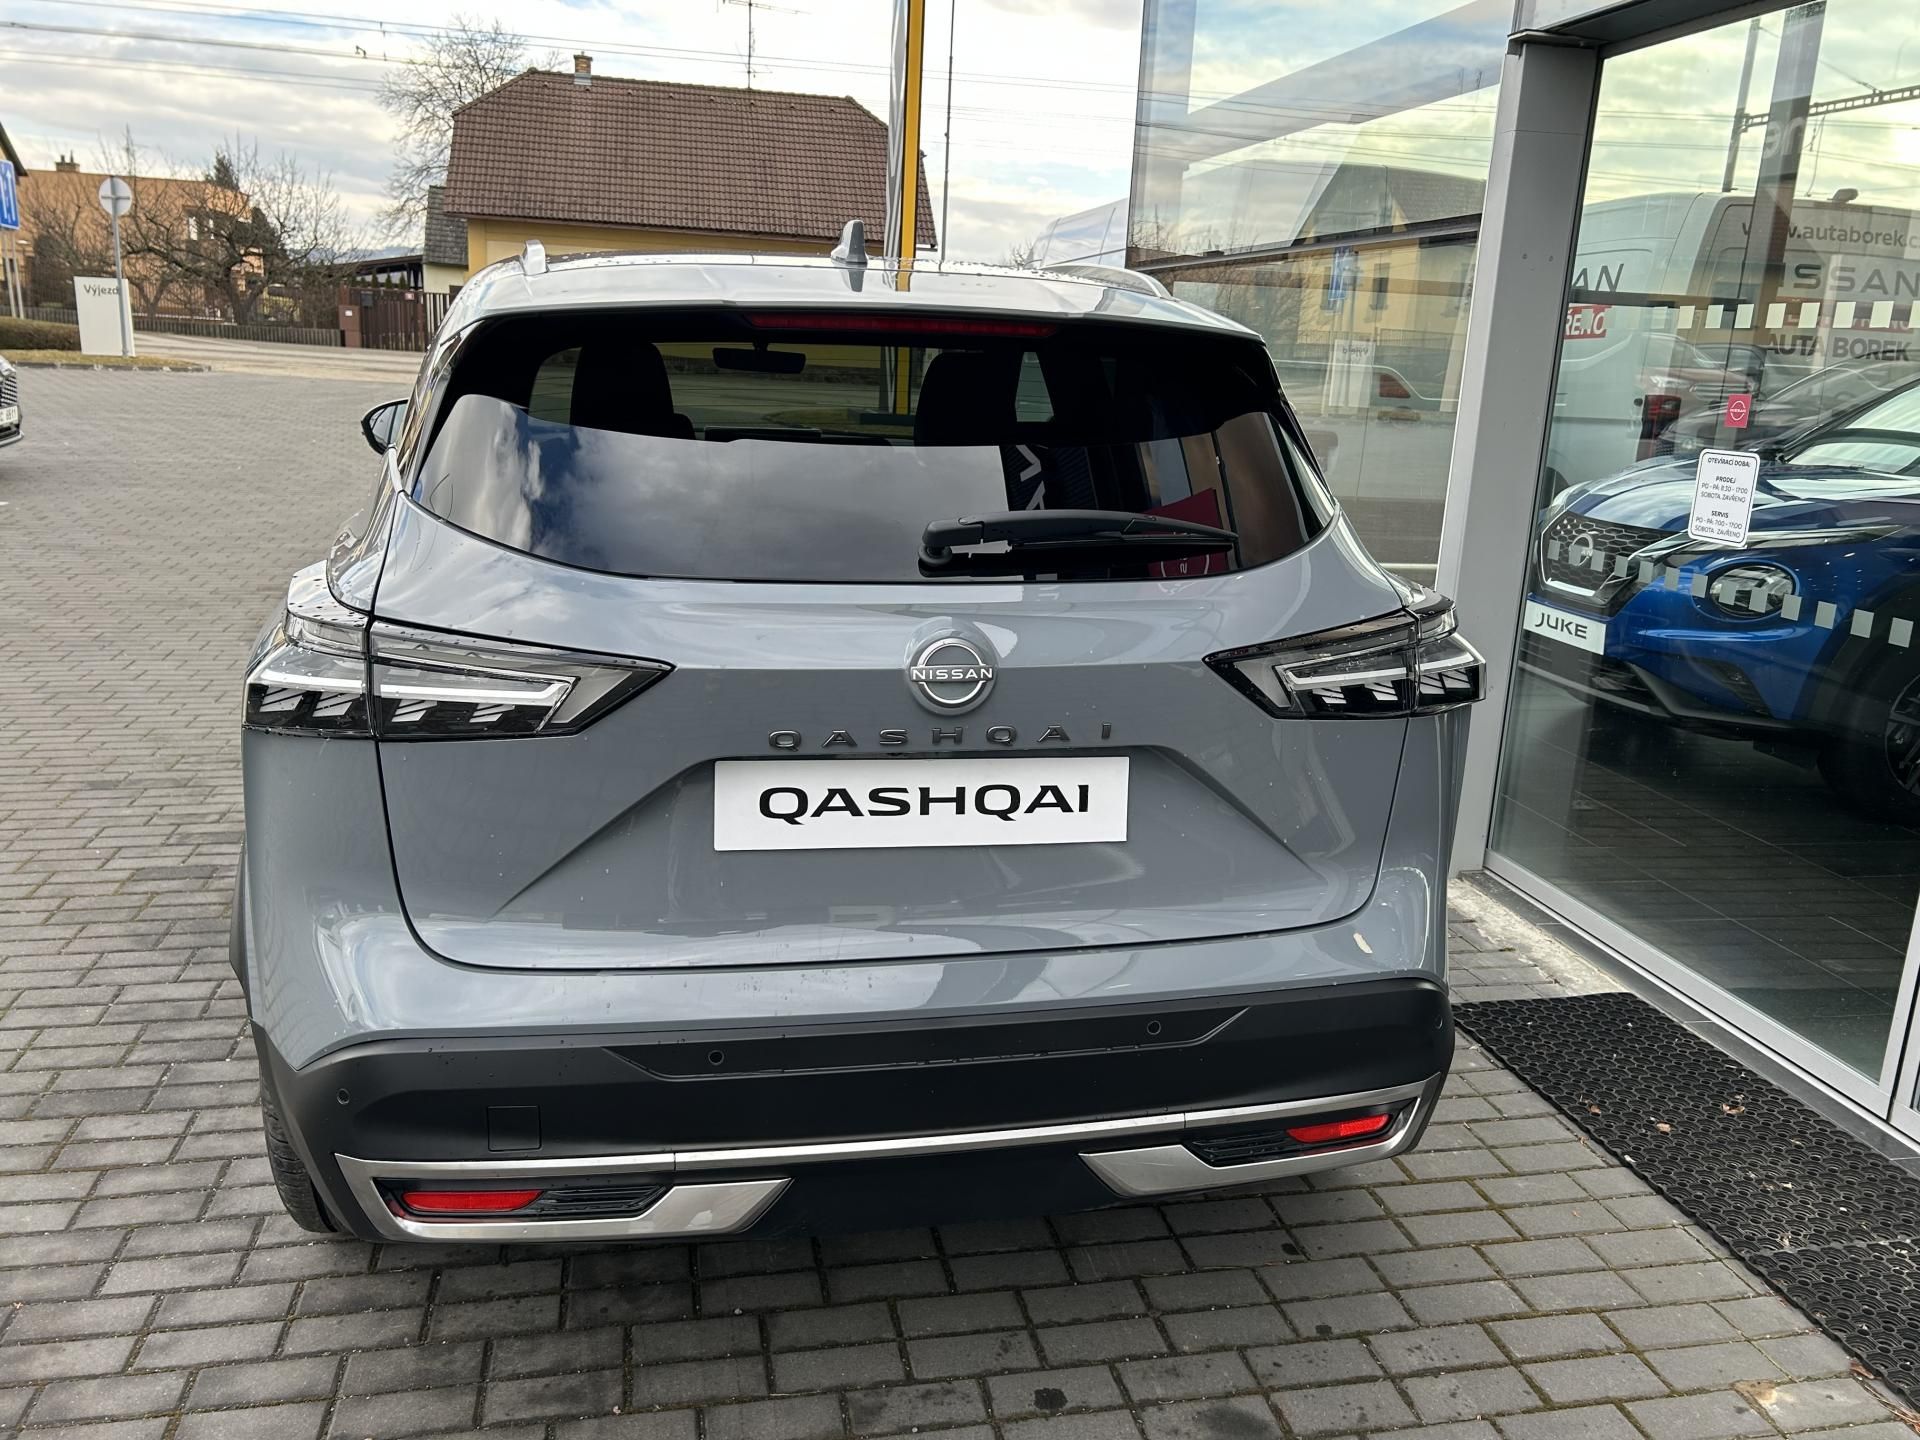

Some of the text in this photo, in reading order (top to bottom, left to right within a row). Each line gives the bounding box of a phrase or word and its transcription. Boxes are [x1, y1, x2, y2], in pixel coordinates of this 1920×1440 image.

[83, 284, 119, 296] Výjezd
[1769, 334, 1912, 361] AUTA BOREK
[1715, 475, 1737, 484] PRODEJ
[1711, 510, 1729, 518] SERVIS
[1535, 612, 1588, 639] JUKE
[912, 666, 993, 680] NISSAN
[768, 722, 1113, 752] QASHQAI
[758, 784, 1090, 826] QASHQAI
